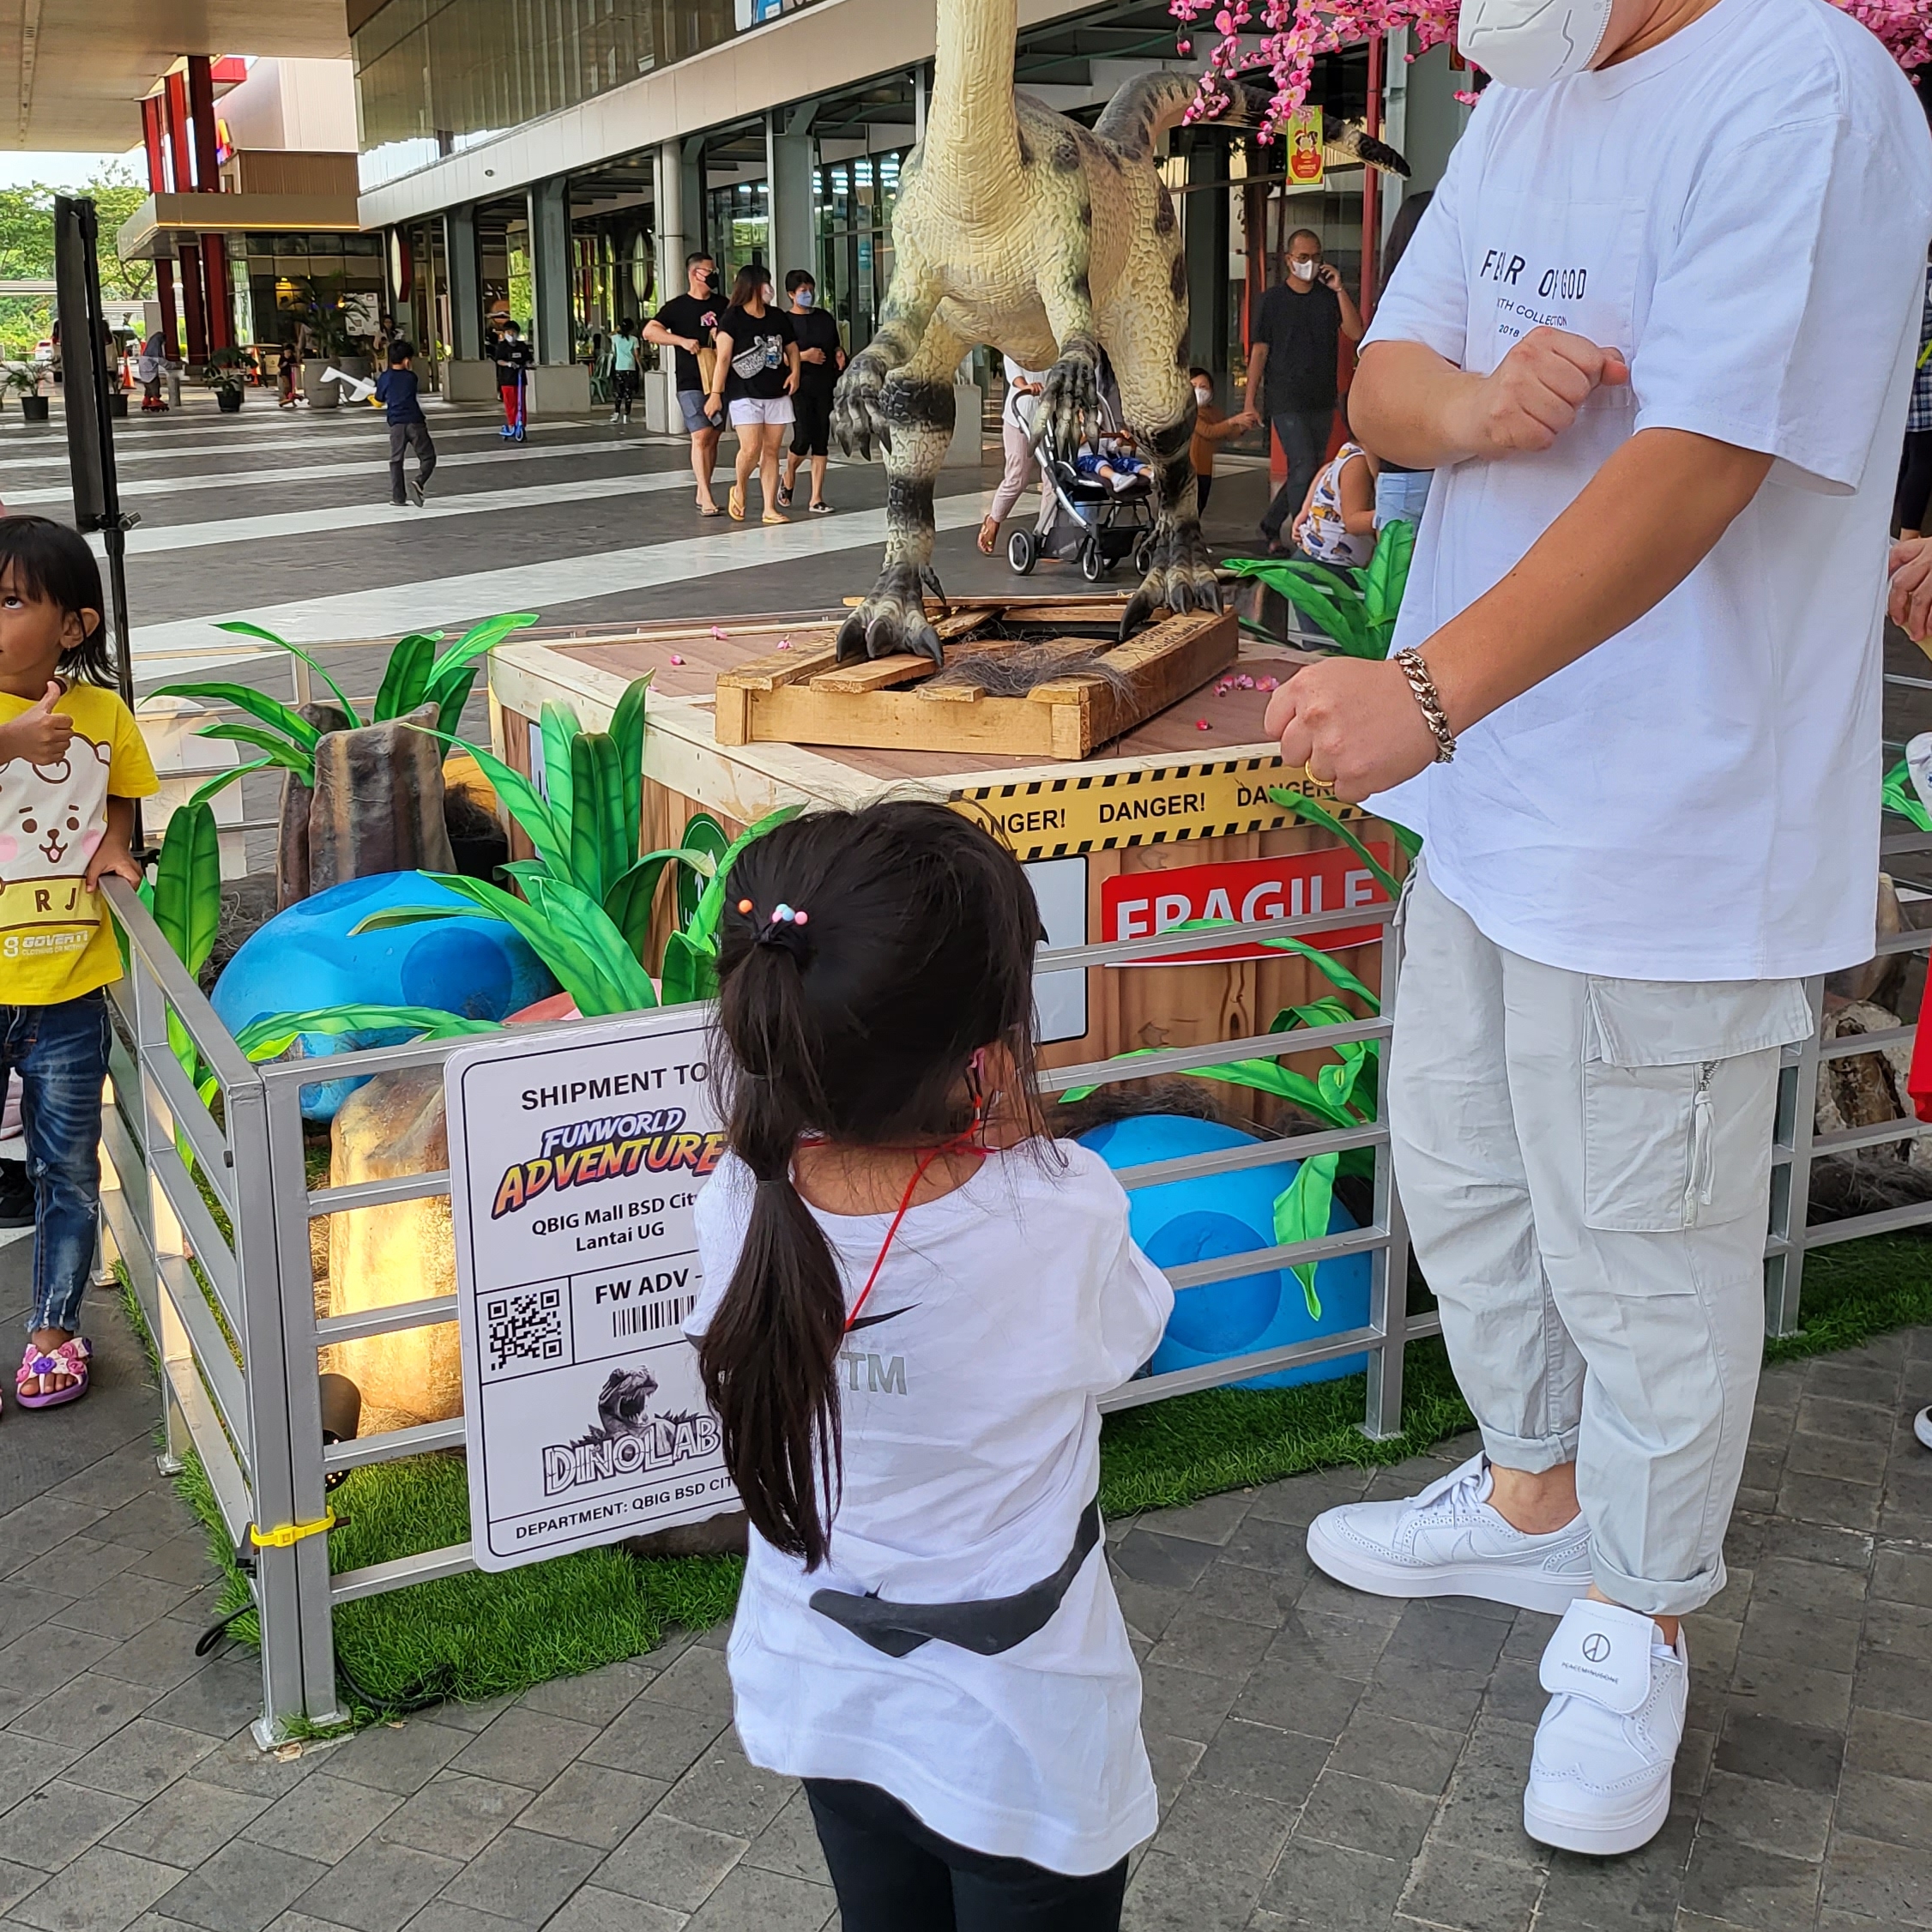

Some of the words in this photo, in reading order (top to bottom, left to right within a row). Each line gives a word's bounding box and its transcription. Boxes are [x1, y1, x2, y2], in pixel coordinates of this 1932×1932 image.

[1561, 269, 1587, 299] GOD
[1498, 324, 1520, 337] 2018
[1516, 305, 1567, 327] COLLECTION
[975, 808, 1066, 836] ANGER!
[1099, 793, 1205, 824] DANGER!
[1117, 868, 1374, 942] FRAGILE
[521, 1068, 667, 1111] SHIPMENT
[673, 1061, 709, 1085] TO
[540, 1108, 687, 1158] FUNWORLD
[491, 1132, 727, 1220] ADVENTURE
[531, 1212, 580, 1236] QBIG
[584, 1204, 624, 1227] Mall
[628, 1197, 665, 1217] BSD
[669, 1192, 697, 1209] Cit
[576, 1231, 633, 1253] Lantai
[637, 1221, 665, 1241] UG
[595, 1279, 632, 1305] FW
[637, 1268, 690, 1296] ADV
[840, 1351, 908, 1396] TM
[541, 1416, 721, 1497] DINOLAB
[516, 1501, 629, 1539] DEPARTMENT:
[631, 1491, 671, 1511] QBIG
[675, 1482, 705, 1500] BSD
